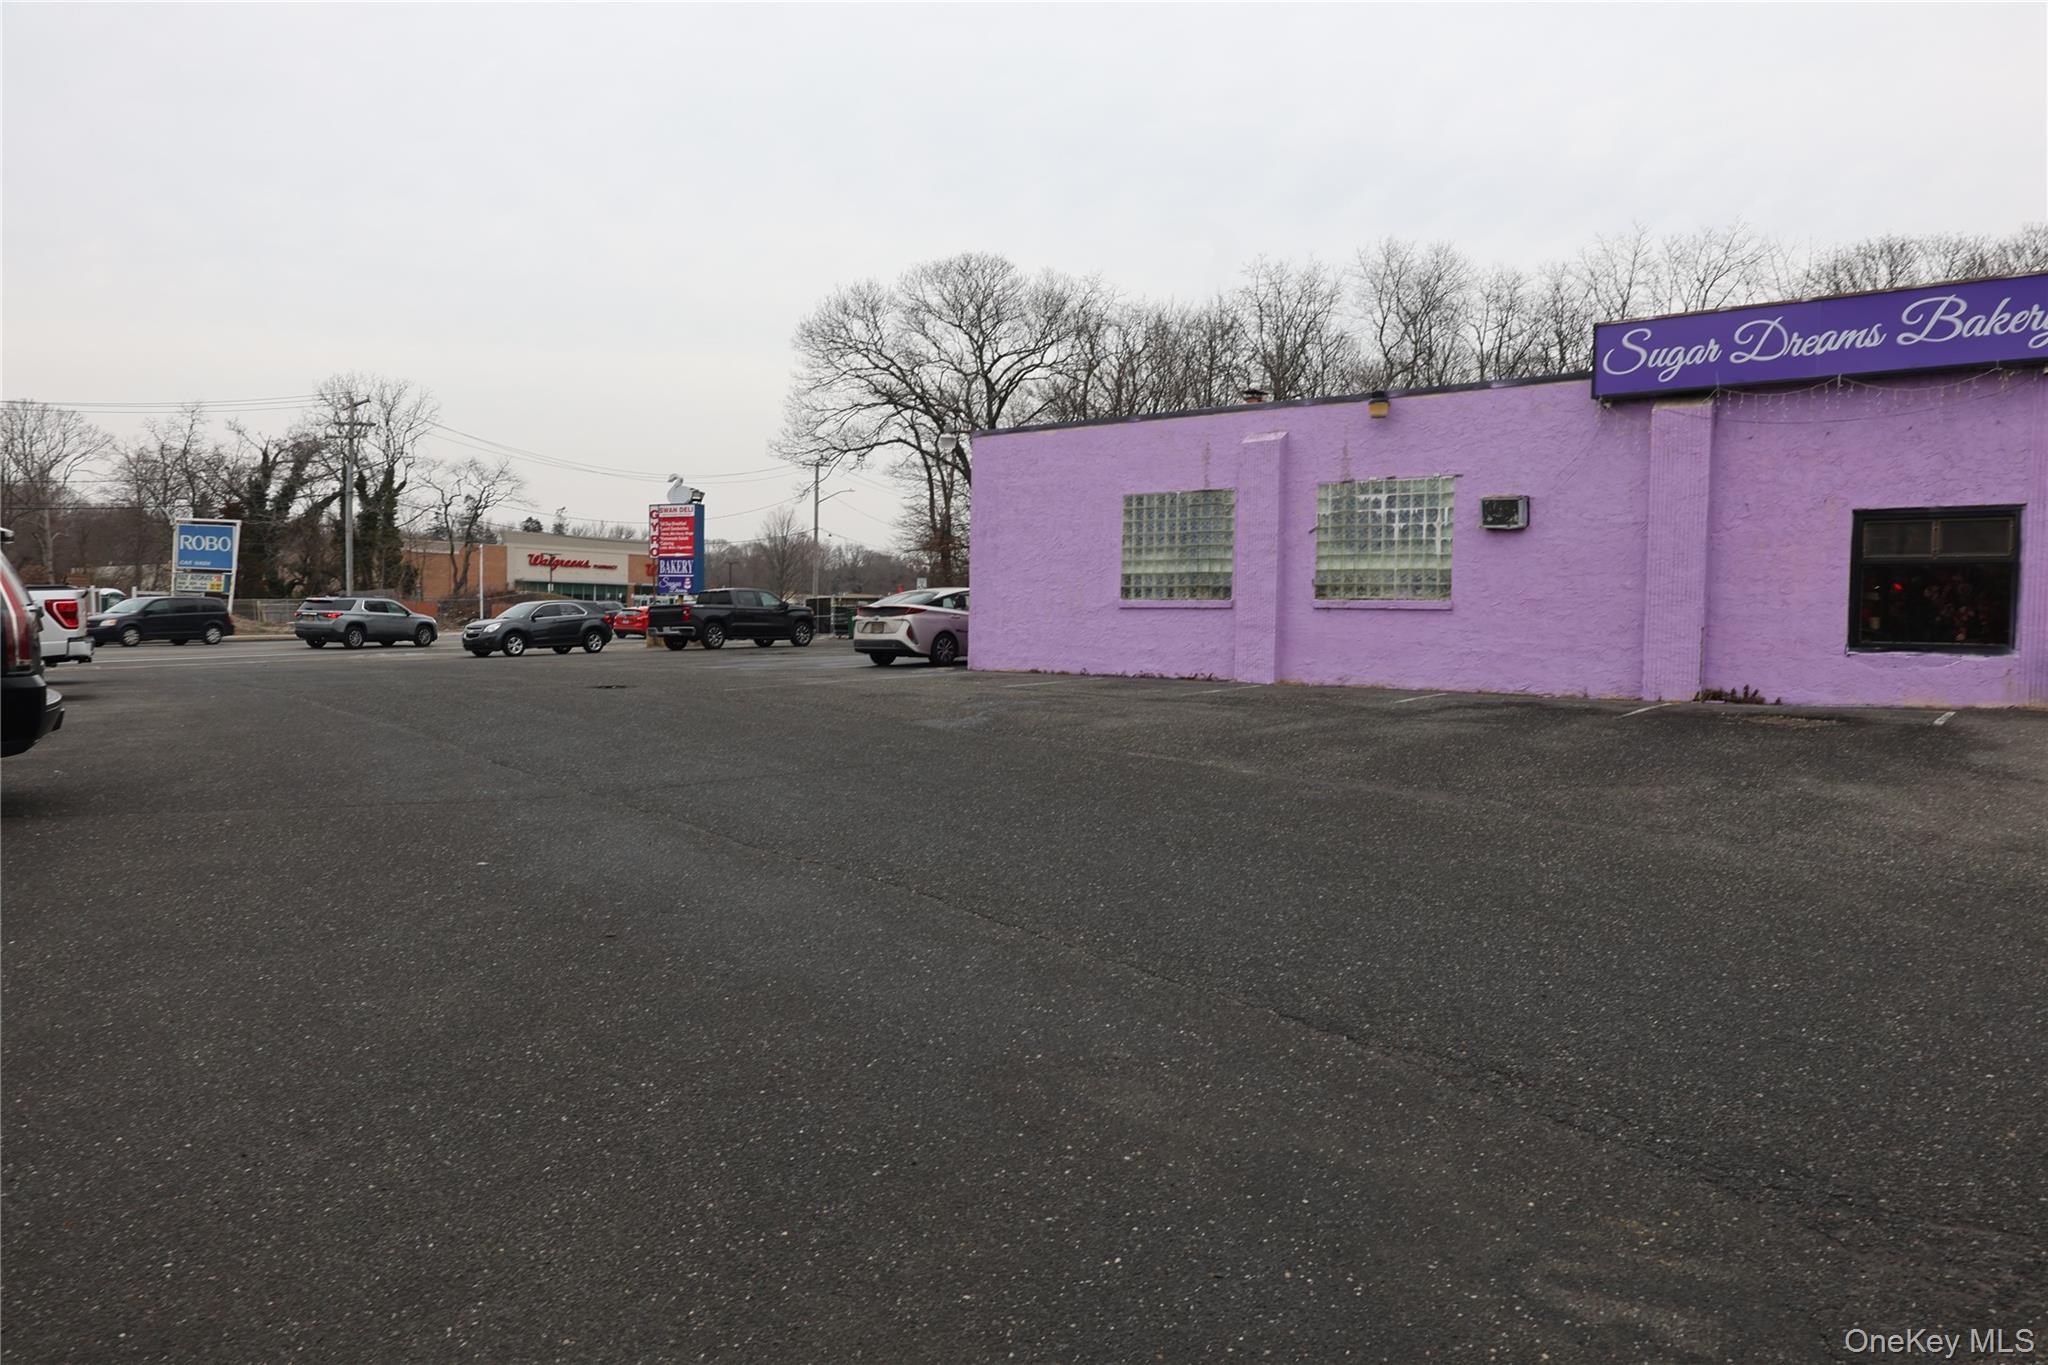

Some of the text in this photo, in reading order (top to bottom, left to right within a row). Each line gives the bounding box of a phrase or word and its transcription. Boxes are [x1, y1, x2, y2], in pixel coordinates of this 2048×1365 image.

[1602, 328, 1721, 383] Sugar
[1729, 316, 1887, 364] Dreams
[180, 535, 232, 552] ROBO
[527, 553, 591, 571] Walgreens
[660, 559, 694, 574] BAKERY
